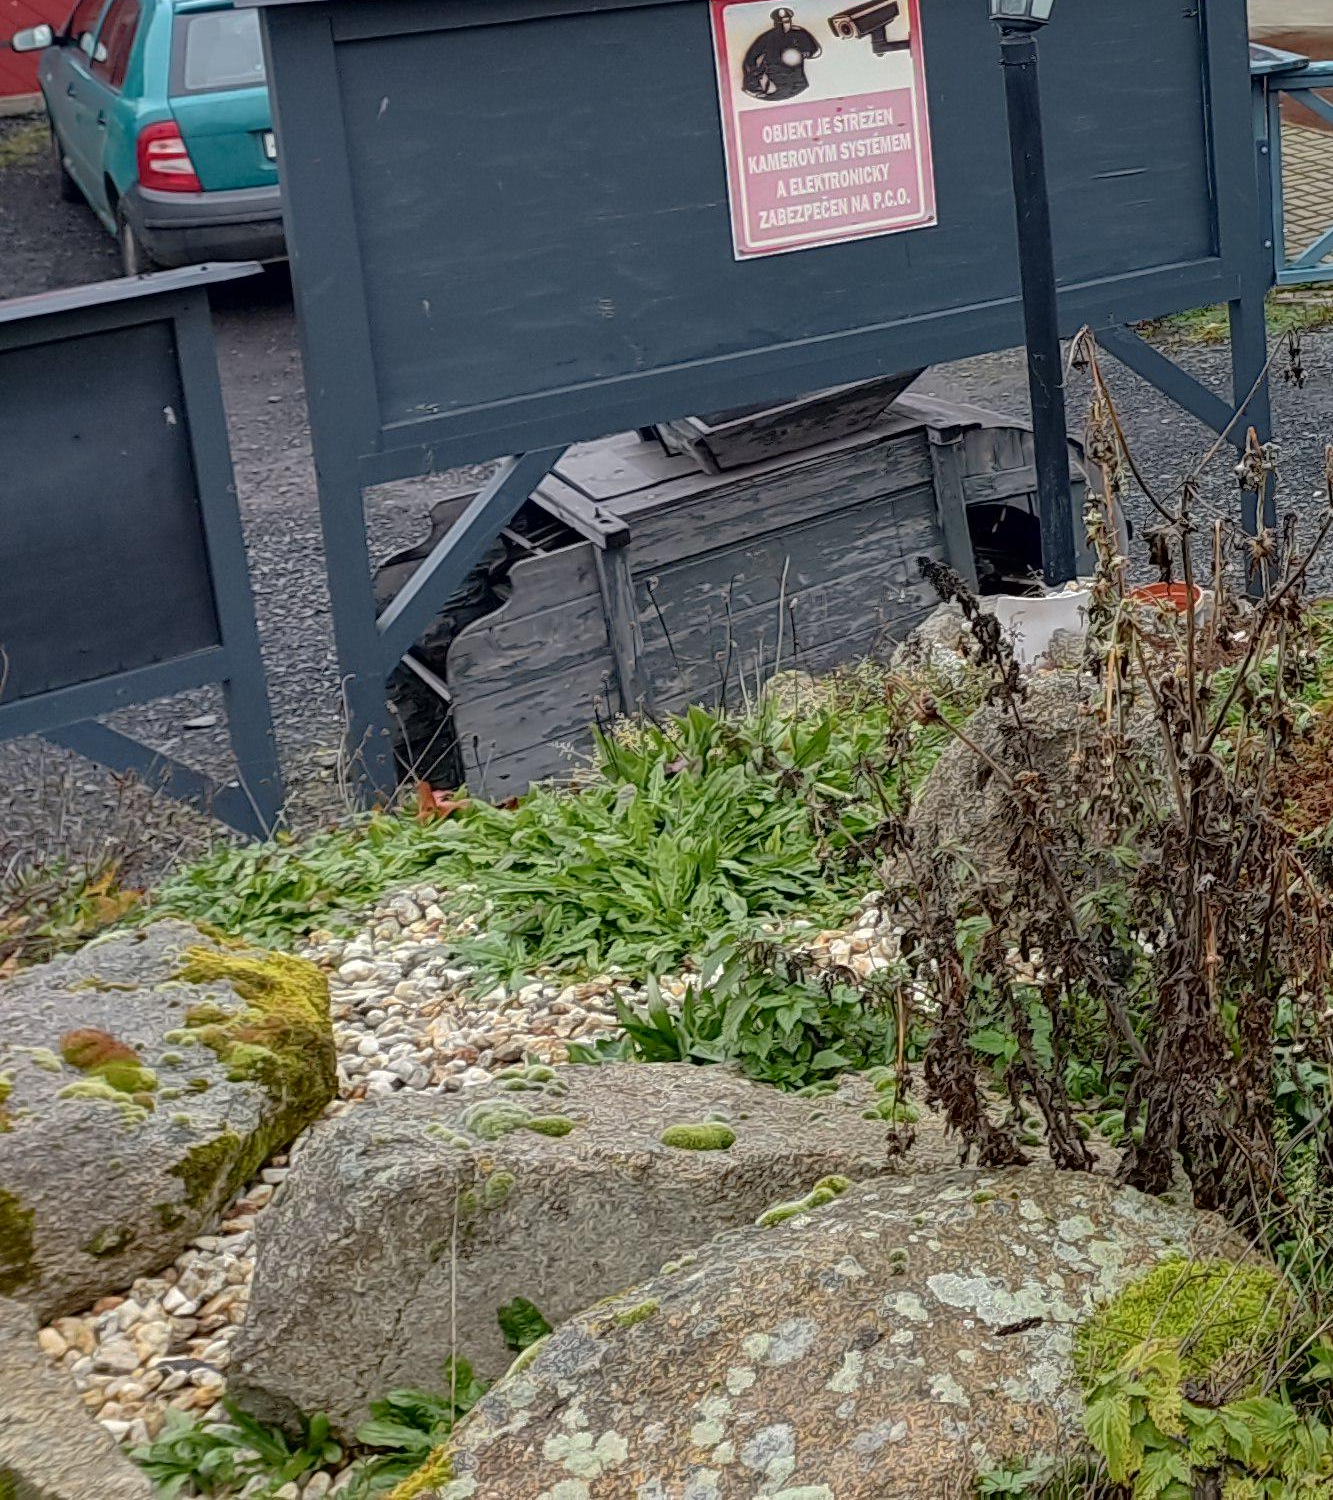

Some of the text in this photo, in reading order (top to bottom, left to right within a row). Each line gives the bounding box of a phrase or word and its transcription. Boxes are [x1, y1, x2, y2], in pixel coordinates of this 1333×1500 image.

[762, 104, 893, 143] OBJEKT JE STŘEŽEN
[747, 132, 912, 174] KAMEROVÝM SYSTÉMEM
[777, 163, 890, 198] A ELEKTRONICKY
[758, 187, 911, 229] ZABEZPEČEN NA P.C.O.
